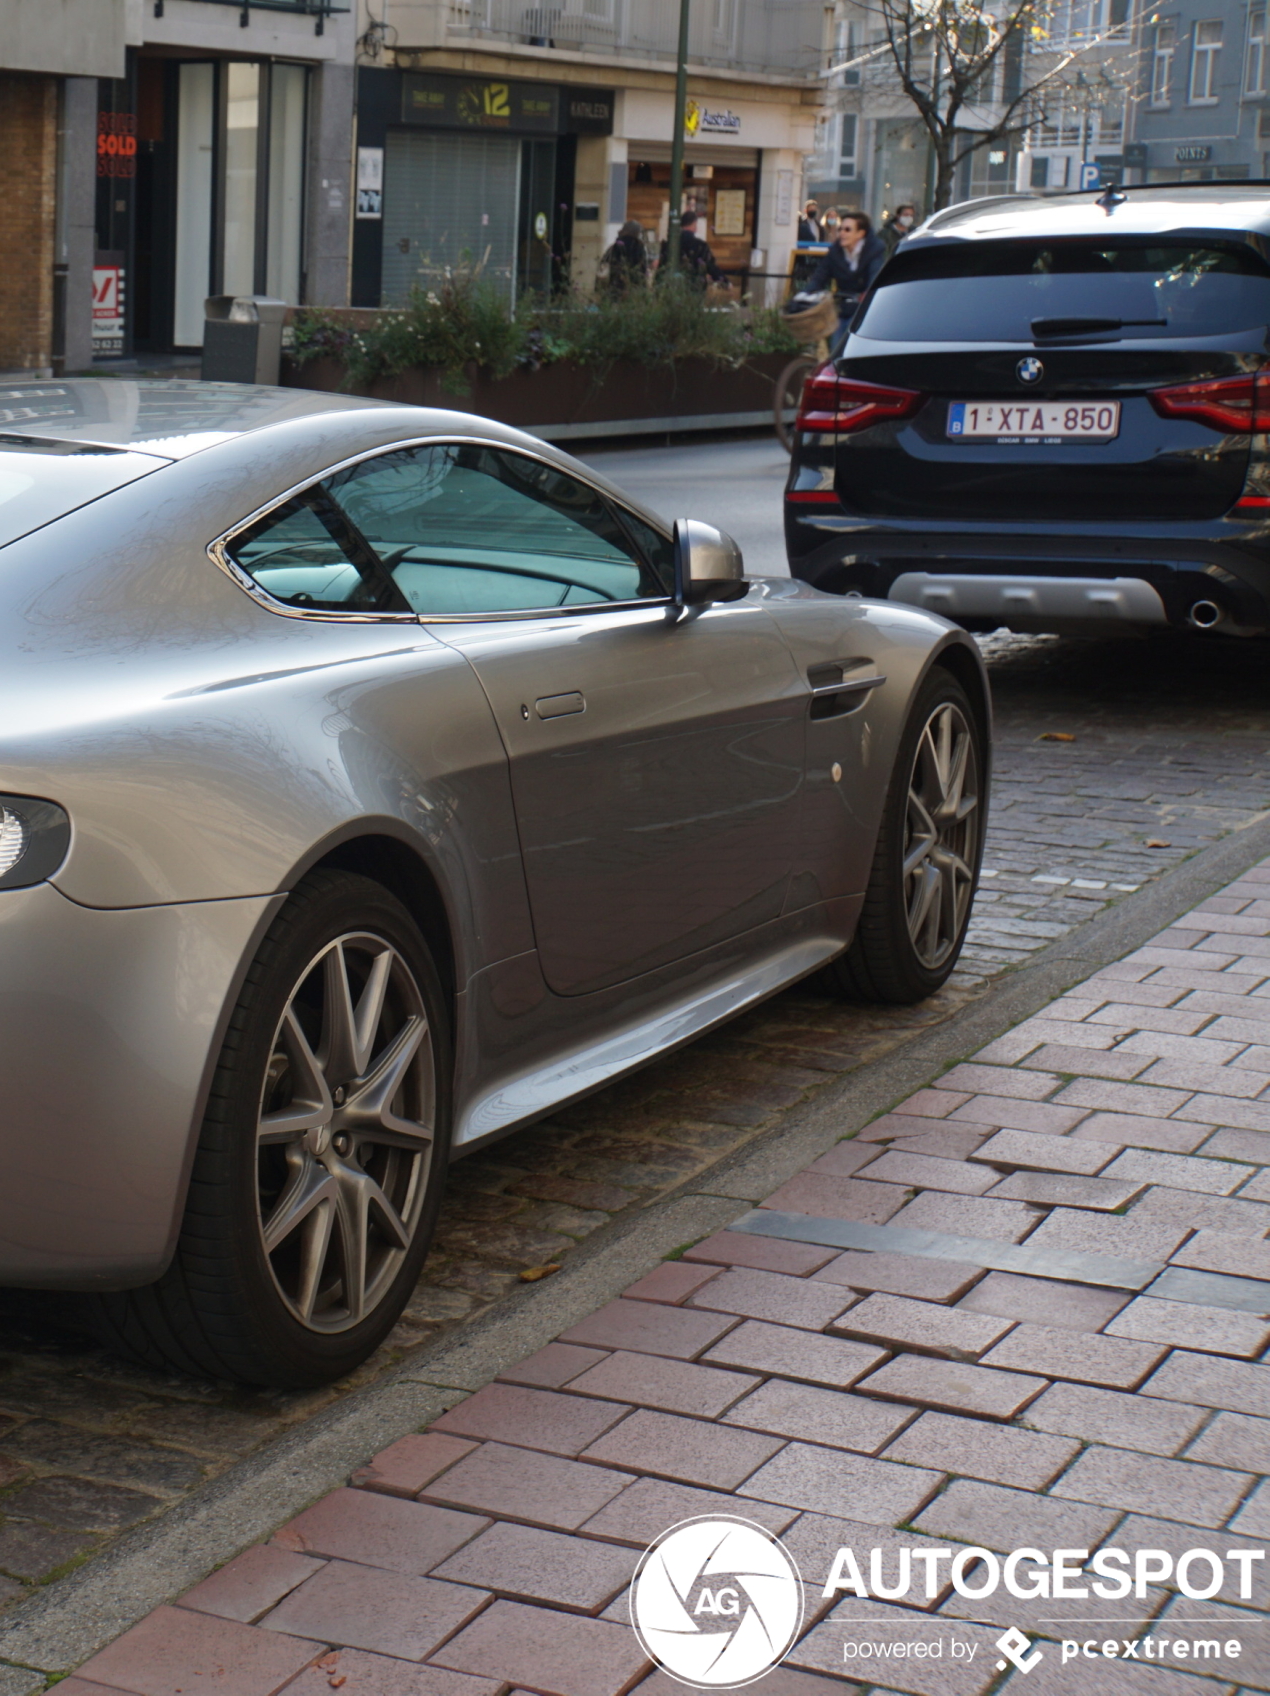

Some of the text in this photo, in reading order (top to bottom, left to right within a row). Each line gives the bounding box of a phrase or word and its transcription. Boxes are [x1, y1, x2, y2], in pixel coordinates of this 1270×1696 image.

[484, 83, 511, 116] 12
[703, 108, 741, 128] Australian
[97, 134, 137, 155] SOLD
[1083, 165, 1099, 189] P
[952, 422, 962, 433] B
[970, 407, 1114, 431] 1-XTA-850
